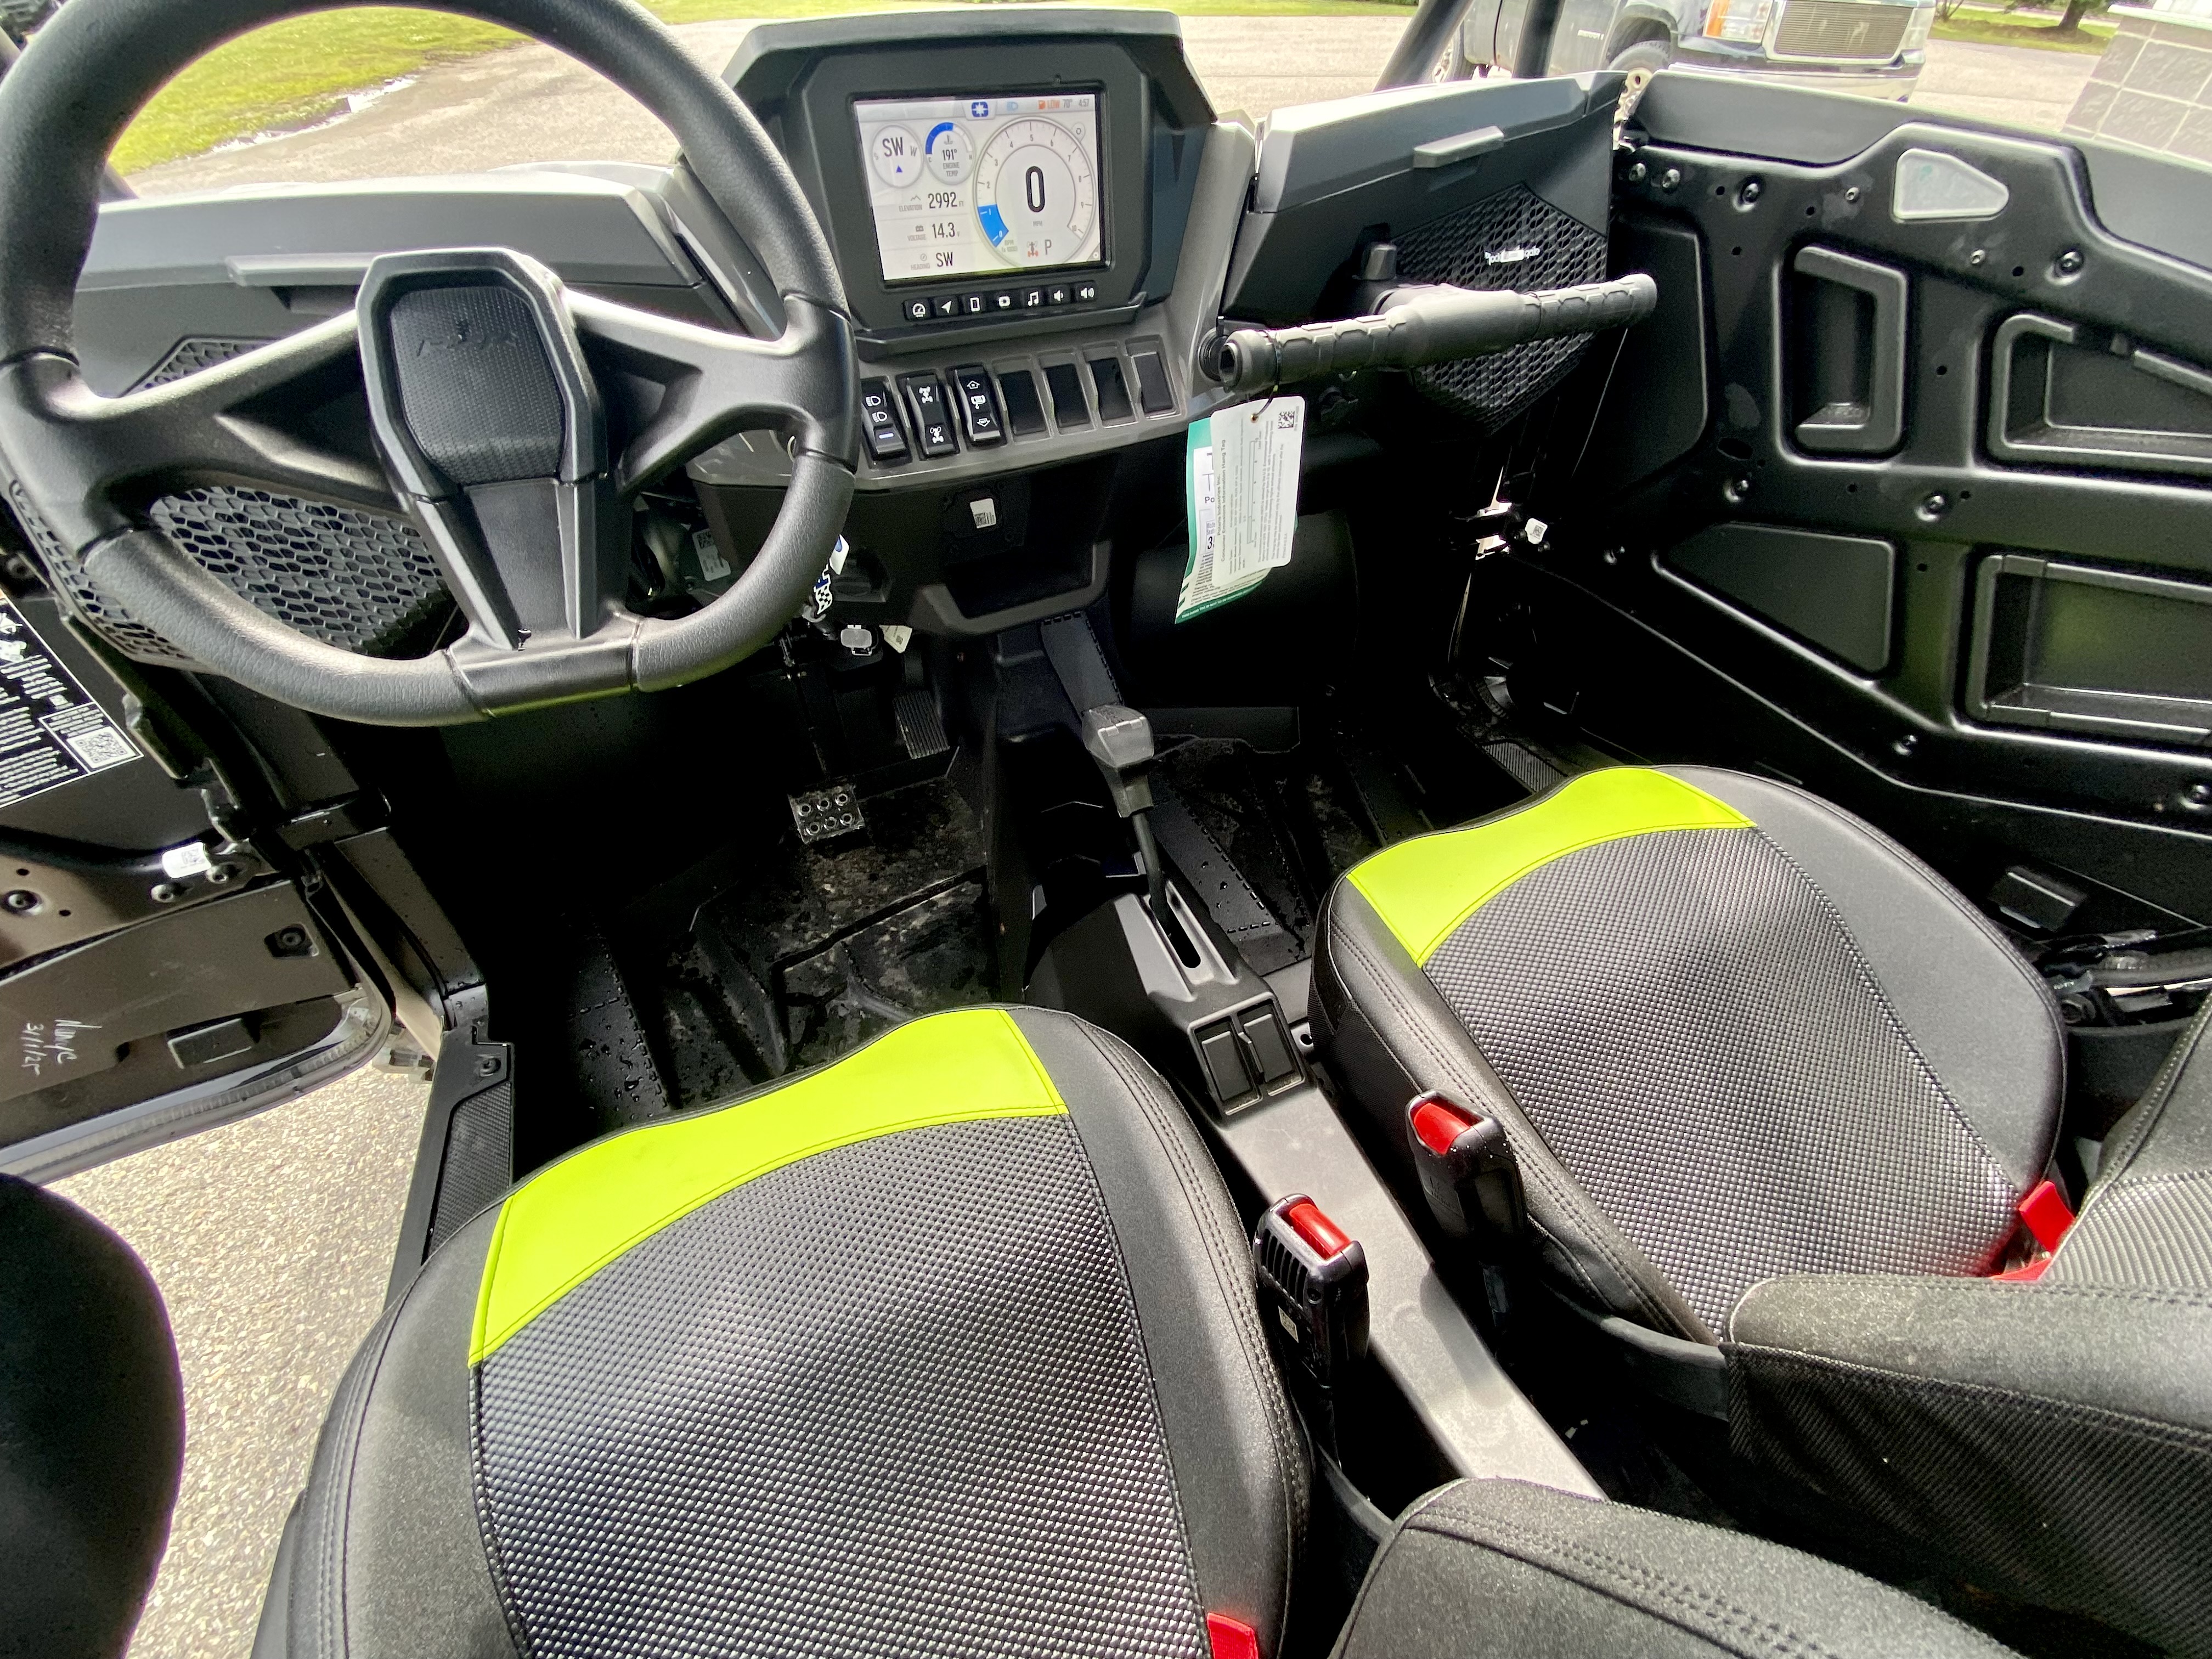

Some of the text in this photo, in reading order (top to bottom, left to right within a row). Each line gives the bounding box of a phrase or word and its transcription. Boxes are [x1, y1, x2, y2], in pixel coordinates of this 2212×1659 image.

[1078, 98, 1090, 107] 4:57
[882, 137, 904, 157] SW
[910, 145, 918, 157] W
[1025, 166, 1045, 213] 0
[899, 204, 923, 212] ELEVATION
[928, 191, 958, 209] 2992
[932, 222, 956, 239] 14.3
[1045, 239, 1052, 255] P
[935, 251, 953, 268] SW
